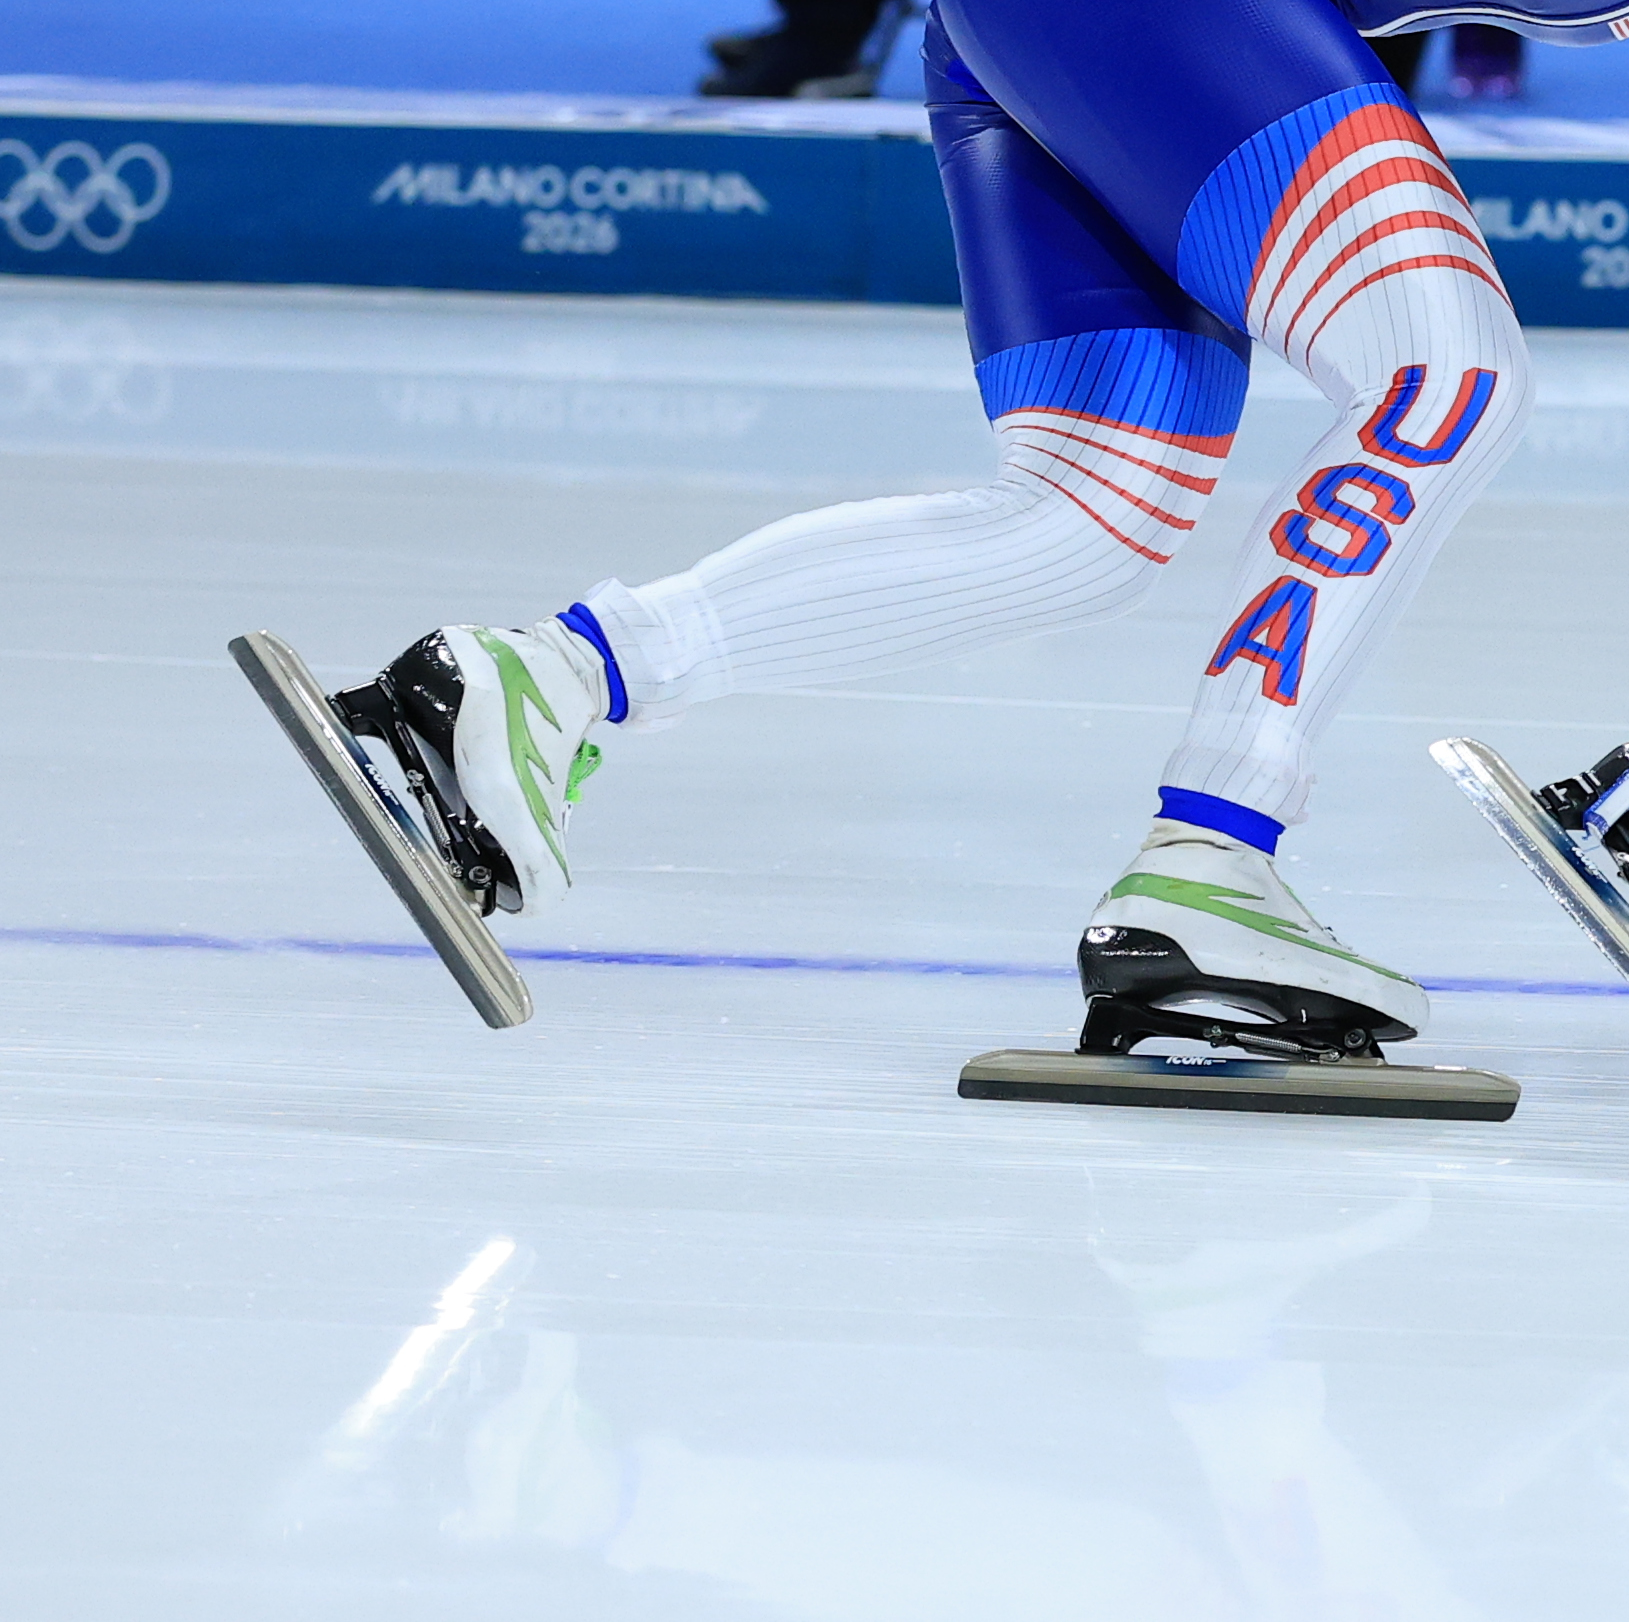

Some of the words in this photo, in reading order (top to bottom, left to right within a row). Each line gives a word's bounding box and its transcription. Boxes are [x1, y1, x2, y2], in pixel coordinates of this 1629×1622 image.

[372, 163, 566, 210] MILANO
[570, 165, 769, 214] CORTINA
[521, 209, 620, 255] 2026
[1471, 197, 1629, 243] ILANO
[1205, 363, 1499, 707] USA
[1165, 1055, 1204, 1066] ICON
